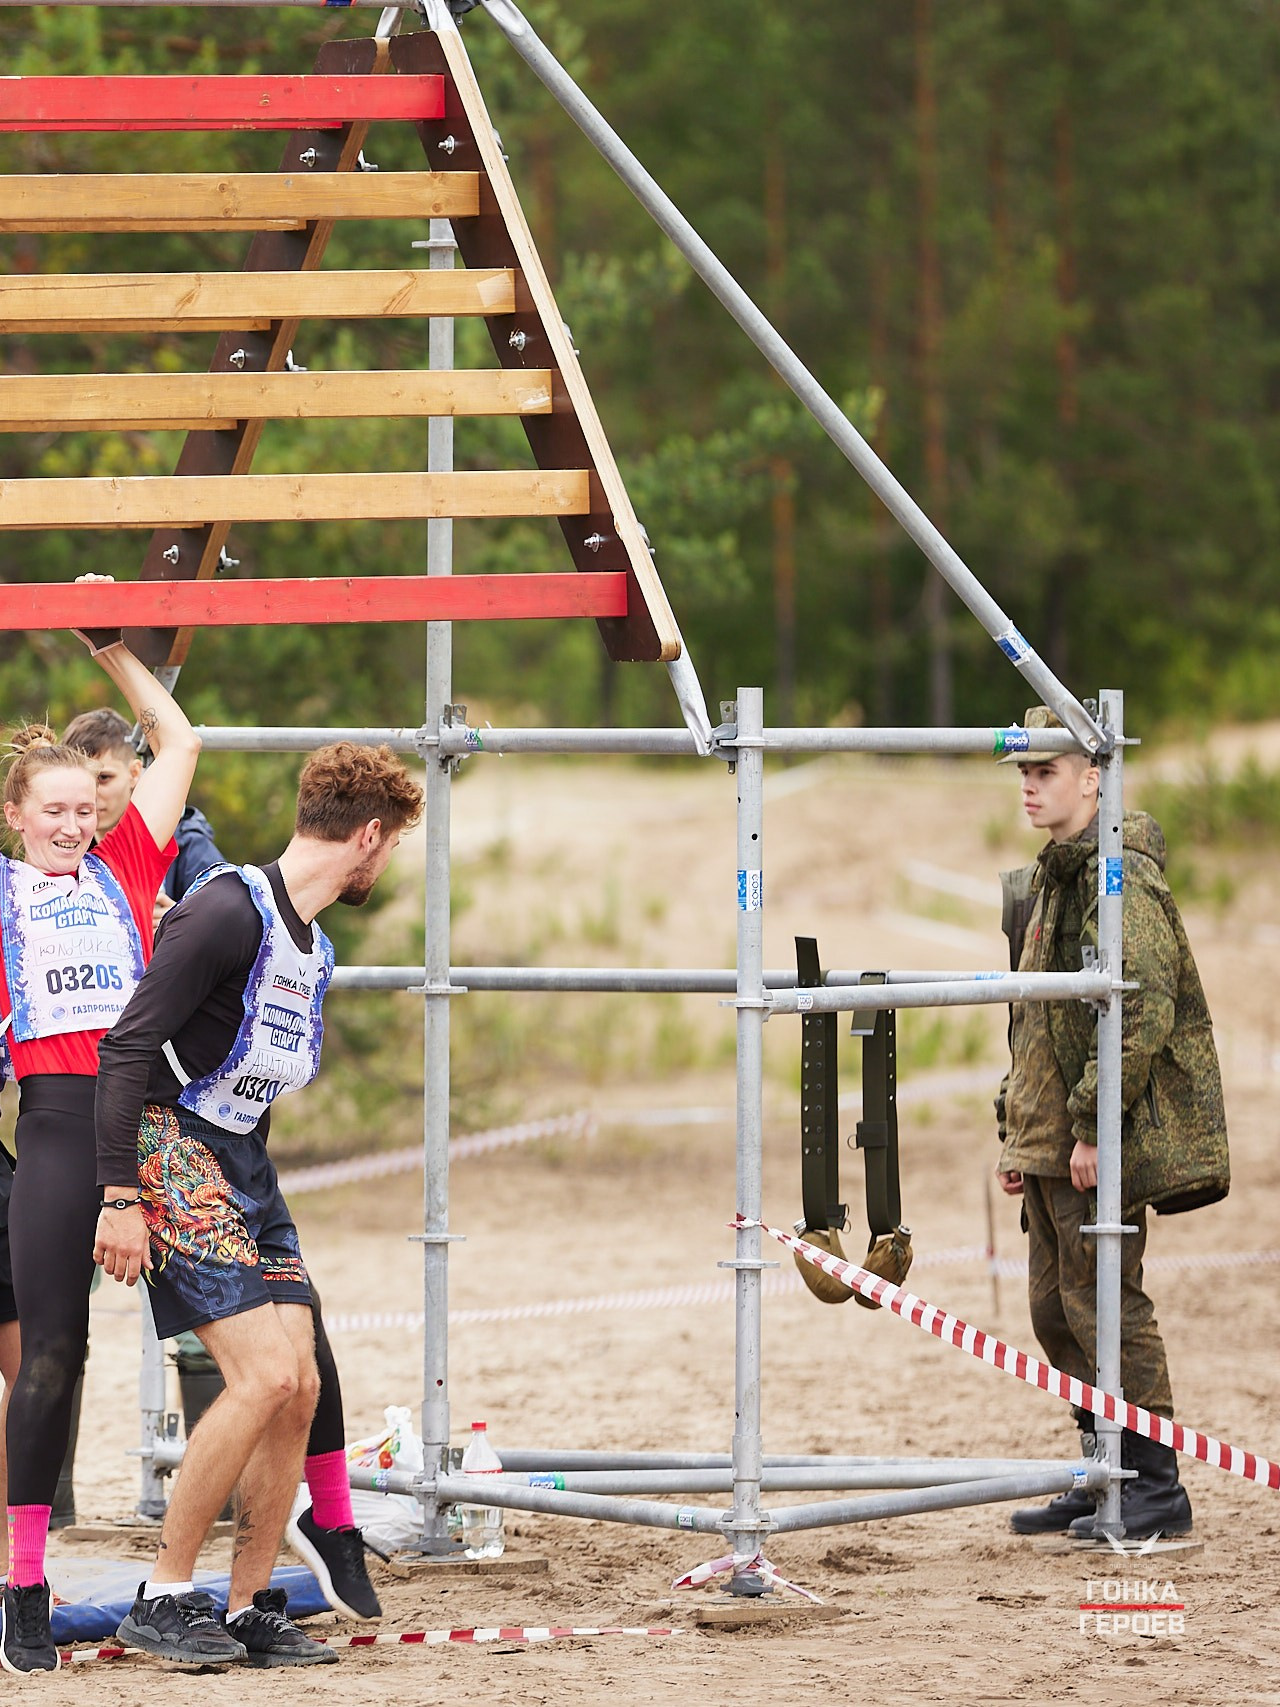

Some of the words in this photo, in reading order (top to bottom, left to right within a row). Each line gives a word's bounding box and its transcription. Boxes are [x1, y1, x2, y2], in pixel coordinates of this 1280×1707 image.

[57, 909, 95, 928] СТАРТ
[46, 964, 123, 995] 03205
[273, 974, 297, 991] ГОНКА
[72, 1003, 126, 1015] ГАЗПРОМБАН
[271, 1028, 300, 1052] СТАРТ
